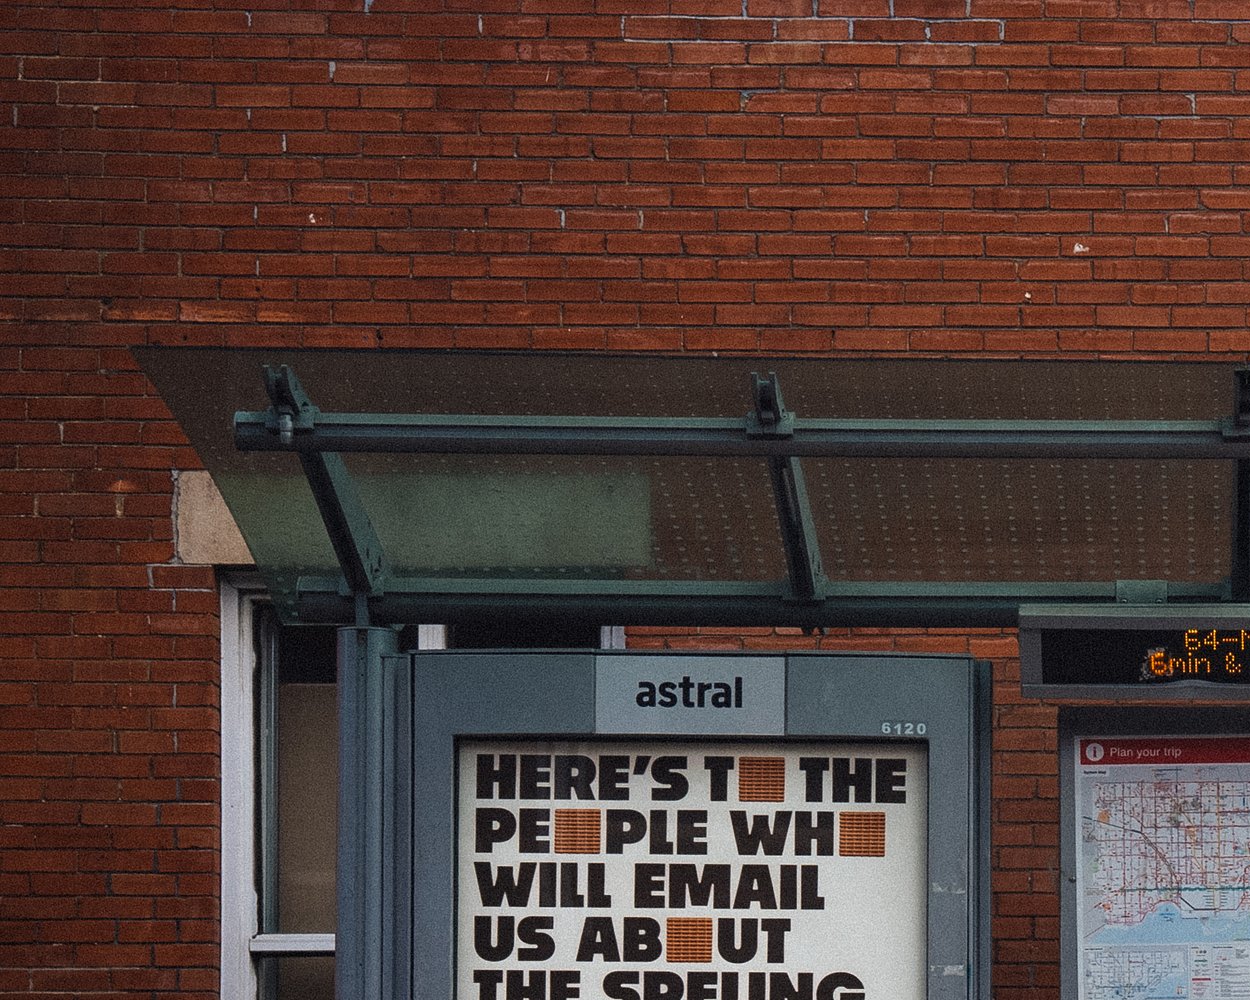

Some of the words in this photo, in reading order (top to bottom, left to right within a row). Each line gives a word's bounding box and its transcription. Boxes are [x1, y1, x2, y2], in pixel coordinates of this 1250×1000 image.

[1149, 652, 1211, 674] 6min
[1225, 652, 1241, 674] &
[636, 676, 743, 708] astral
[881, 722, 927, 735] 6120
[1110, 747, 1133, 757] Plan
[1136, 749, 1159, 760] your
[1163, 747, 1182, 760] trip
[475, 754, 689, 801] HERE'S
[800, 758, 907, 804] THE
[475, 808, 708, 855] PEPLE
[474, 862, 611, 908] WILL
[634, 864, 825, 910] EMAIL
[473, 916, 556, 962] US
[576, 917, 792, 963] ABUT
